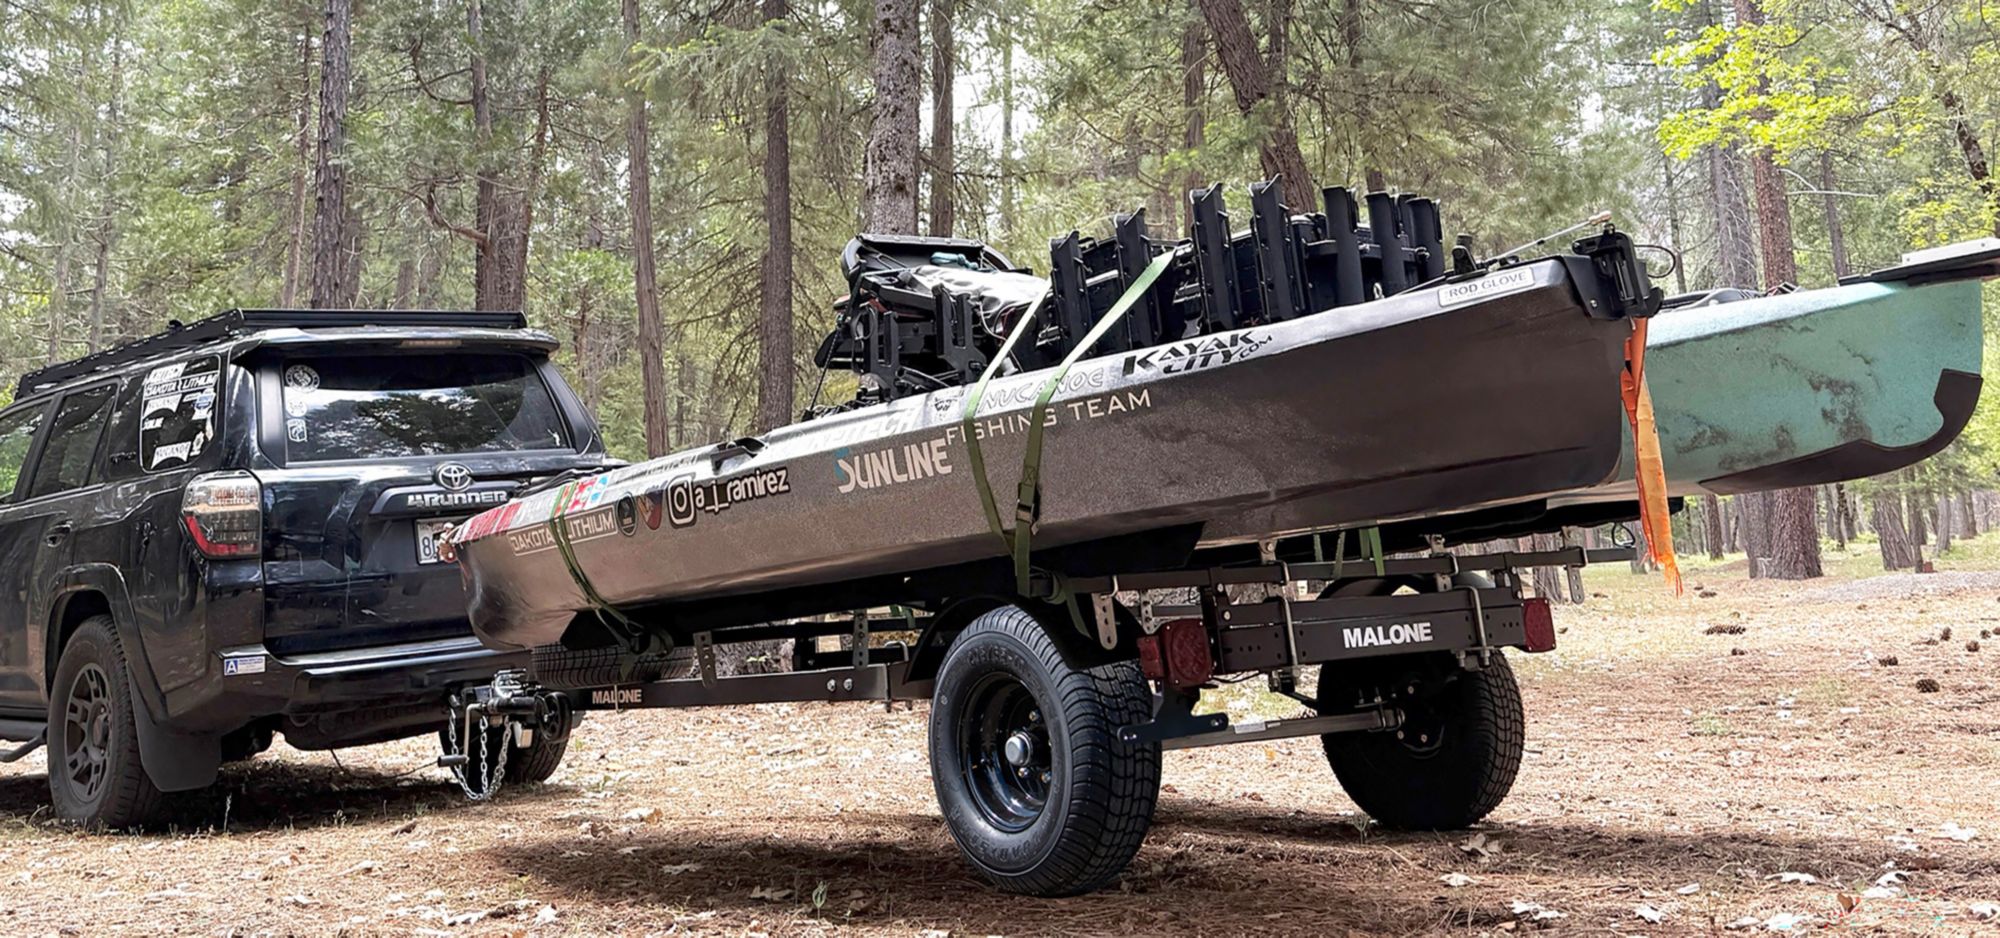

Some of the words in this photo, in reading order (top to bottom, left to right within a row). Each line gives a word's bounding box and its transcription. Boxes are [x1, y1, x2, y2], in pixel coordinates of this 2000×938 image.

[1449, 283, 1478, 297] ROD
[1481, 271, 1526, 290] GLOVE
[1122, 331, 1255, 376] KAYAK
[946, 408, 1058, 446] FISHING
[1067, 389, 1151, 421] TEAM
[833, 438, 953, 493] SUNLINE
[407, 490, 508, 507] 4RUNNER
[695, 469, 790, 513] a_j_ramirez
[510, 528, 556, 552] DAKOTA
[1343, 622, 1434, 649] MALONE
[592, 689, 643, 704] MALONE
